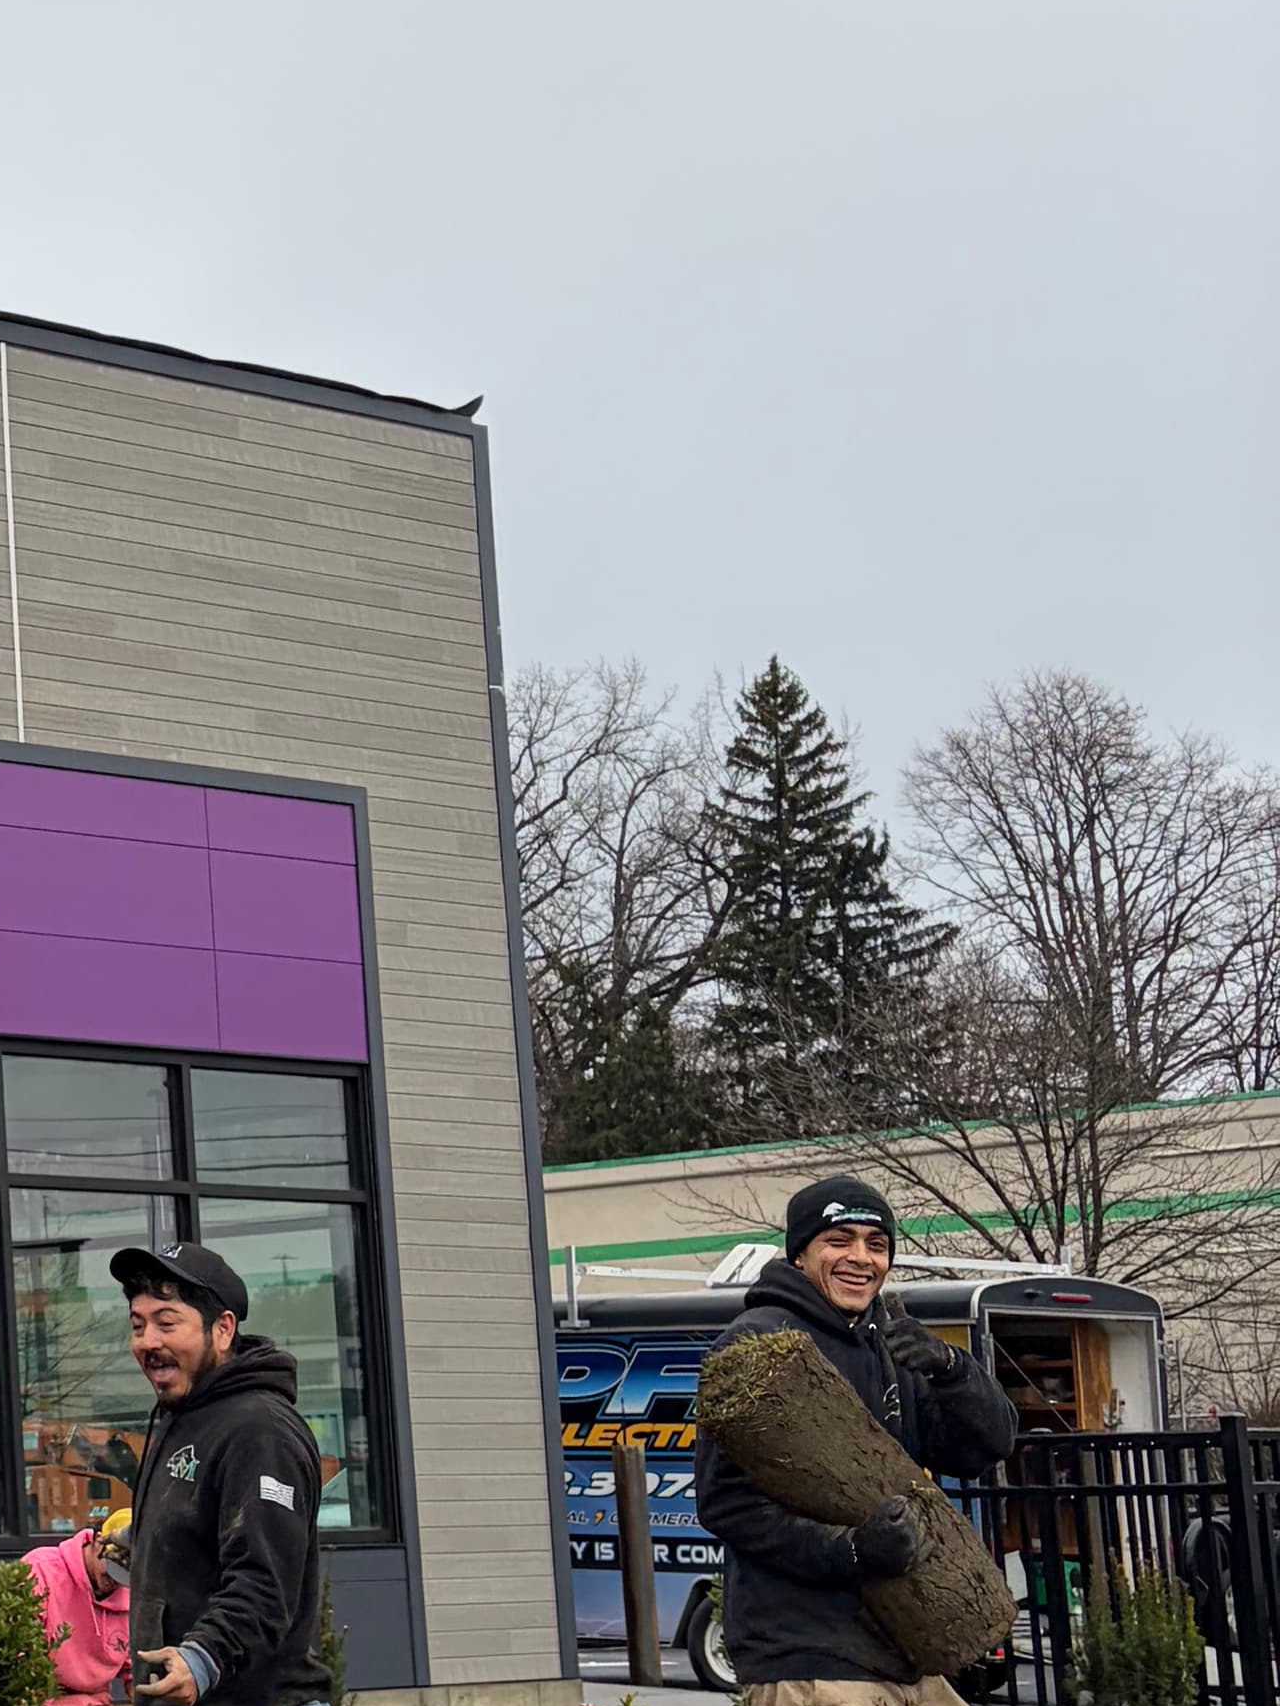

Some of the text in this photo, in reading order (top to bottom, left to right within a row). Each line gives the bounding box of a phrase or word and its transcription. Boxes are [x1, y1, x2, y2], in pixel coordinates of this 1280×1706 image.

[556, 1346, 708, 1415] PF
[560, 1423, 696, 1447] LECT
[570, 1541, 589, 1560] Y
[594, 1542, 615, 1561] IS
